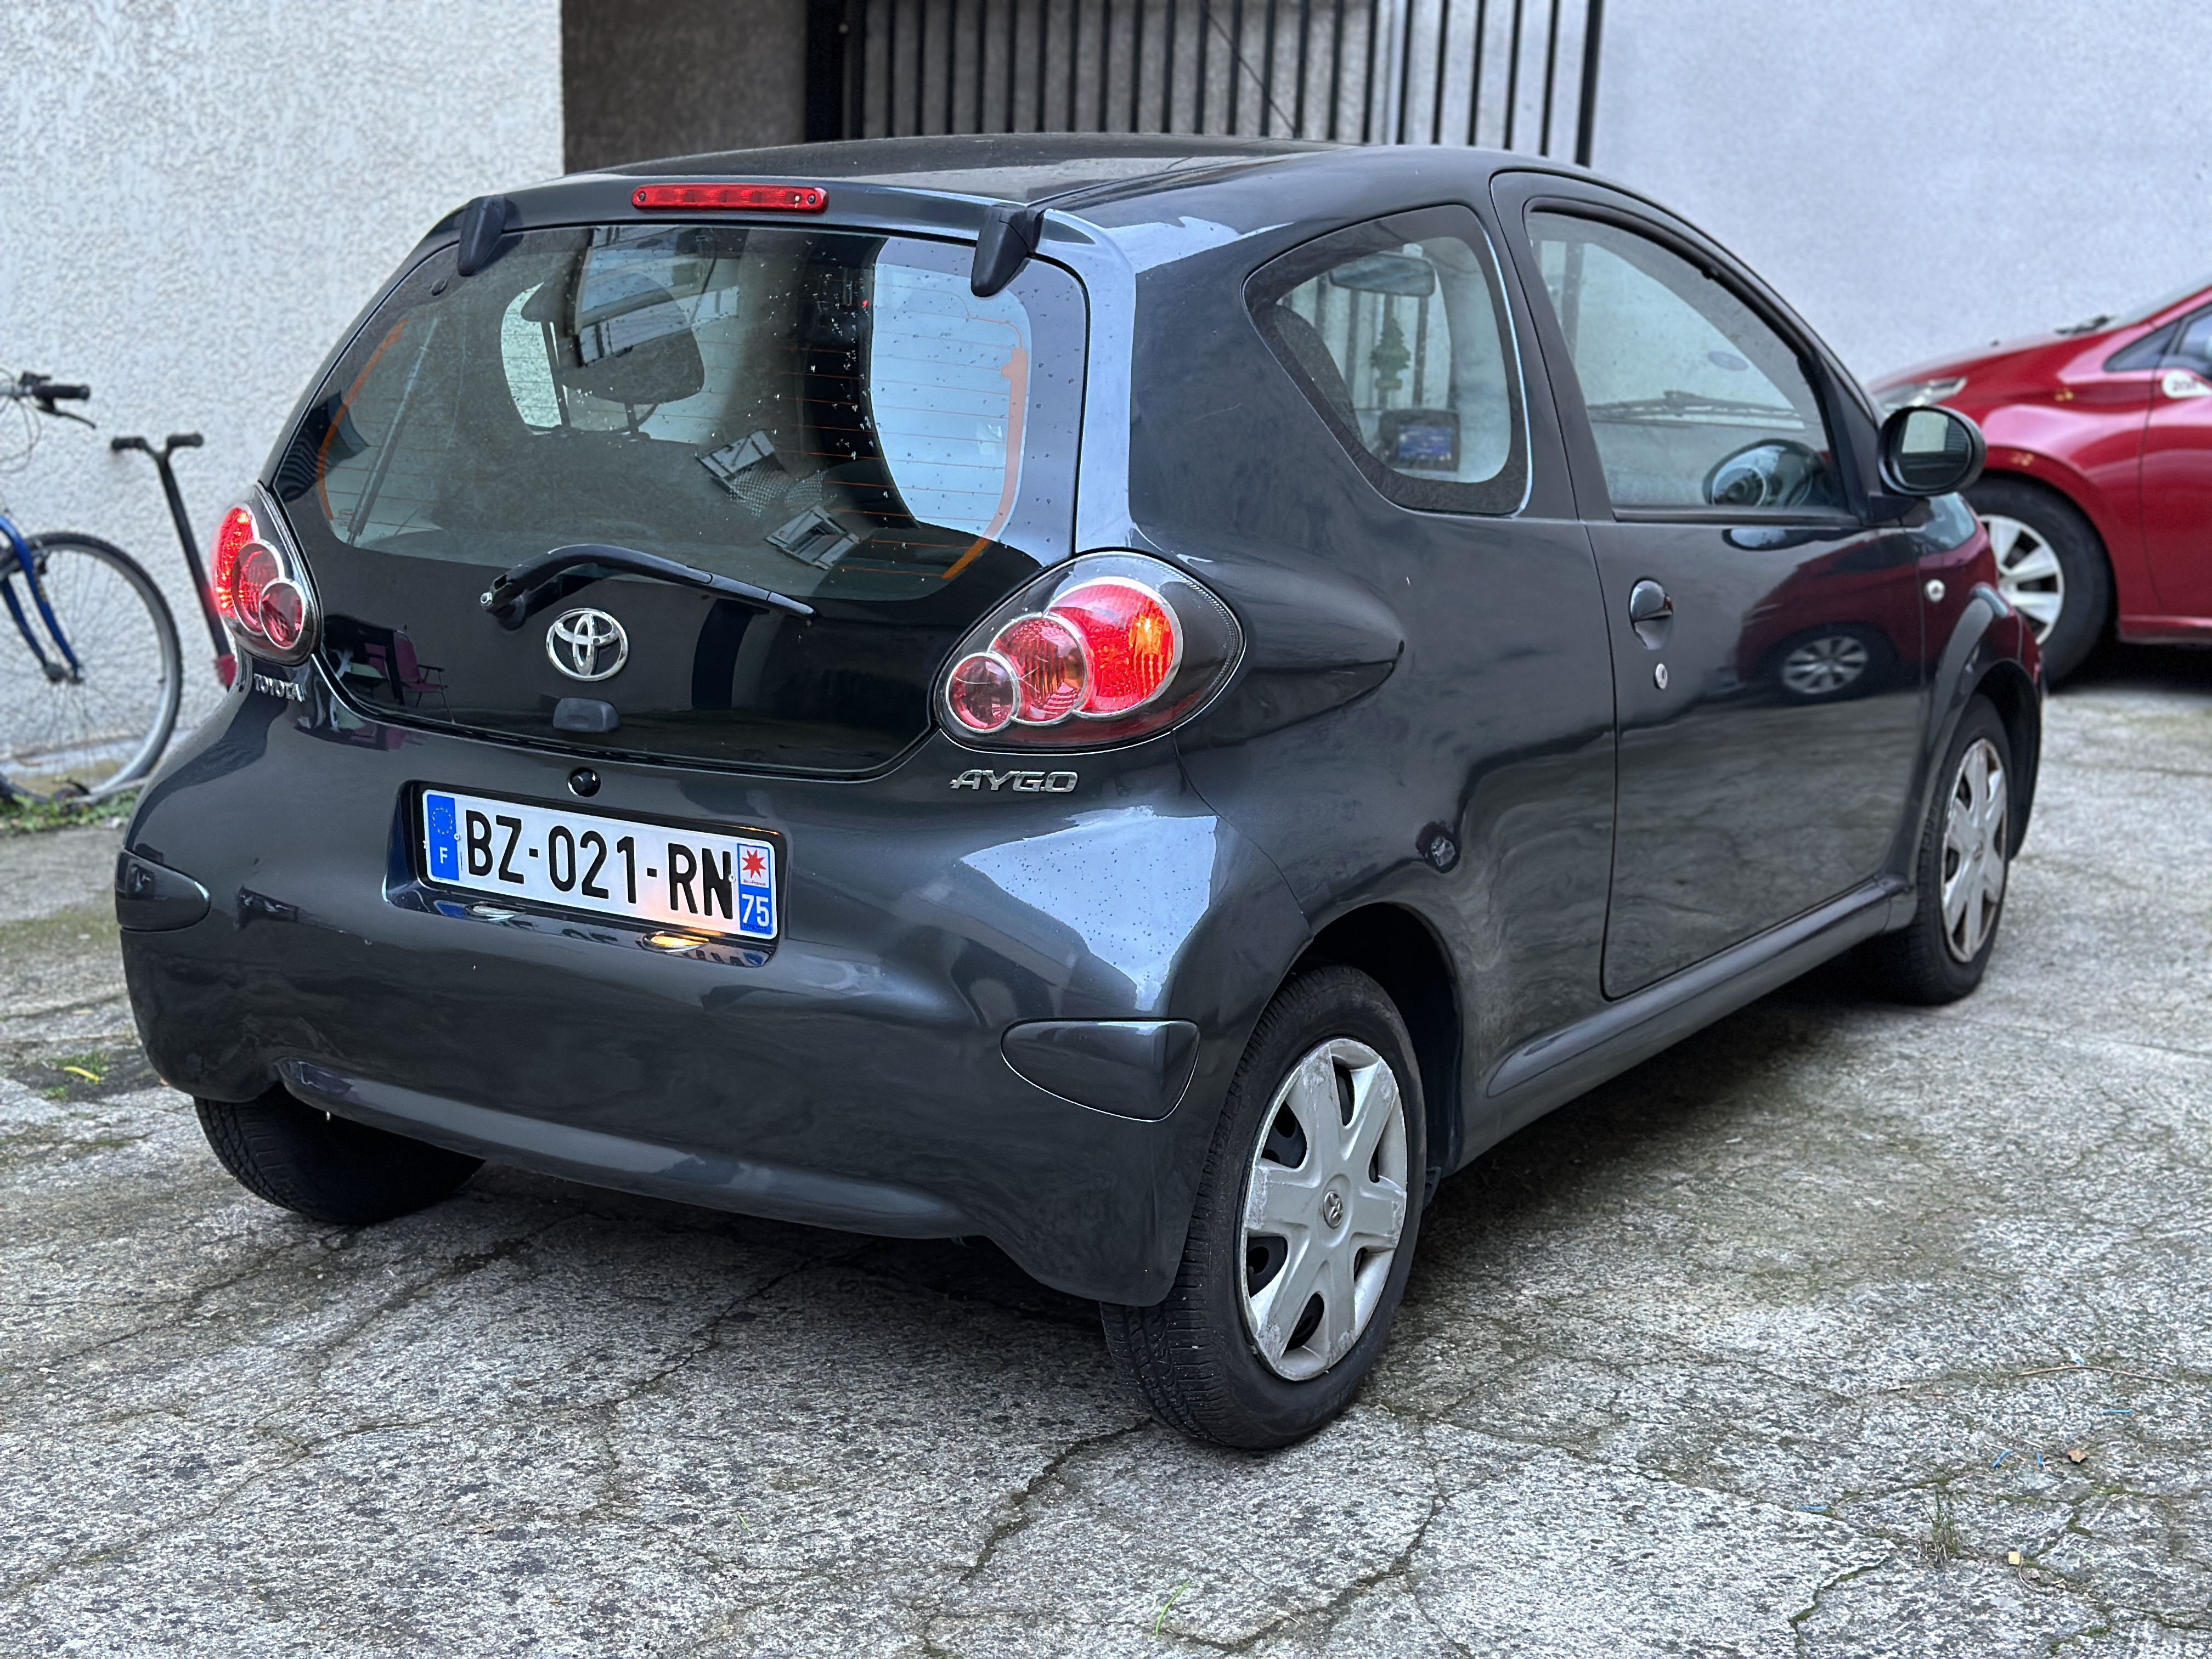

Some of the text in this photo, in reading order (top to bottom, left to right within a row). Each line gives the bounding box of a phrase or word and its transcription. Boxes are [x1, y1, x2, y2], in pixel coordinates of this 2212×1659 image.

[253, 673, 306, 702] TOYOTA
[950, 769, 1078, 792] AYGO
[439, 846, 448, 864] F
[466, 809, 733, 919] BZ-021-RN
[741, 893, 770, 927] 75
